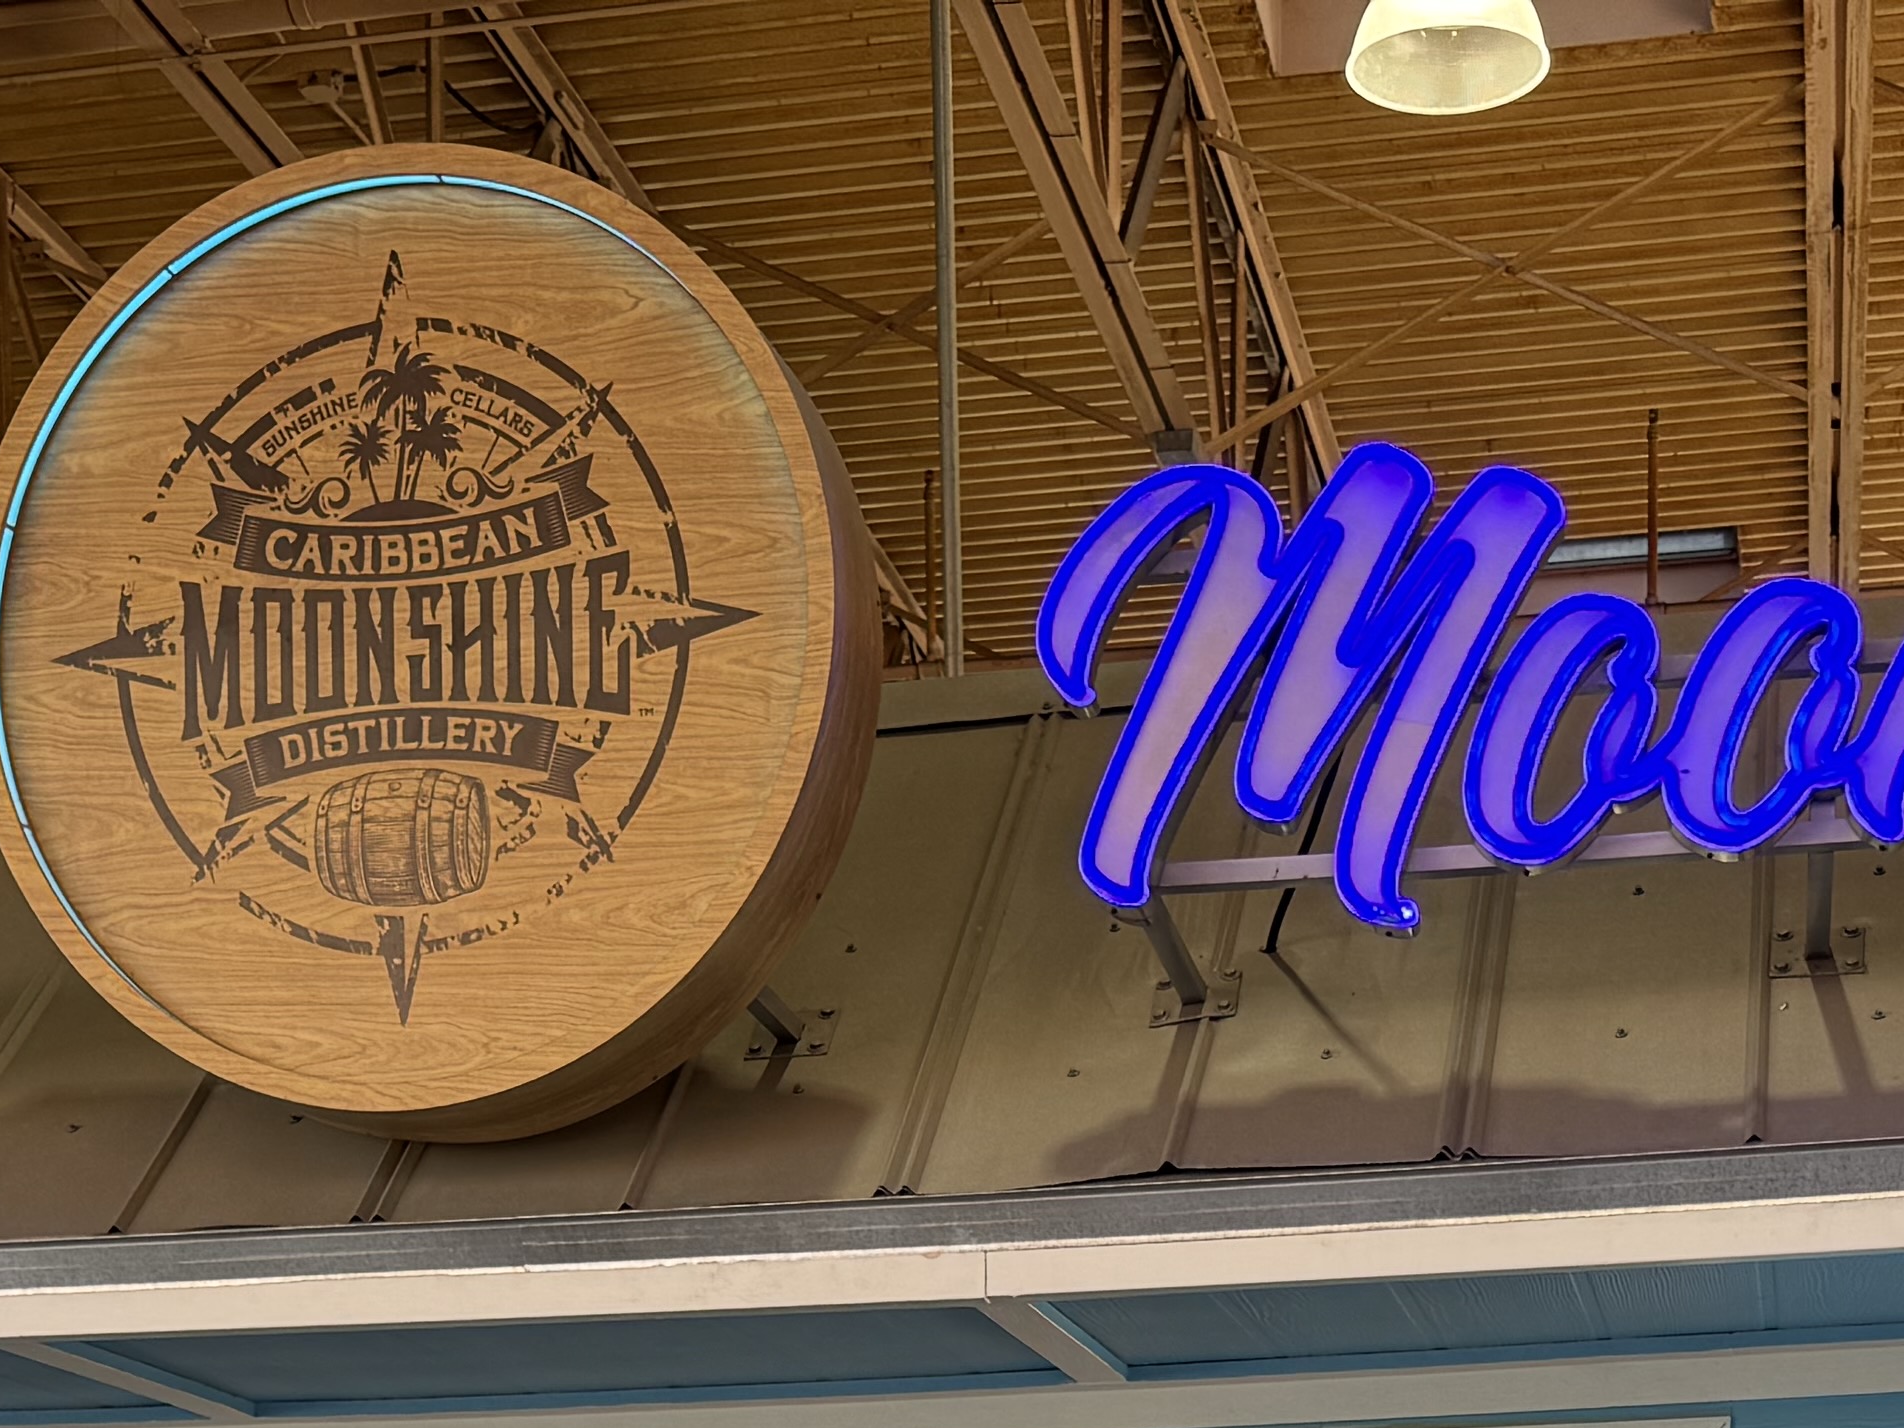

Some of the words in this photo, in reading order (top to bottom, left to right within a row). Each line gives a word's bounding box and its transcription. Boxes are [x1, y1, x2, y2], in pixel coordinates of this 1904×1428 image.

[261, 391, 359, 458] SUNSHINE
[449, 387, 536, 438] CELLARS
[264, 508, 543, 575] CARIBBEAN
[179, 550, 631, 742] MOONSHINE
[278, 716, 525, 769] DISTILLERY
